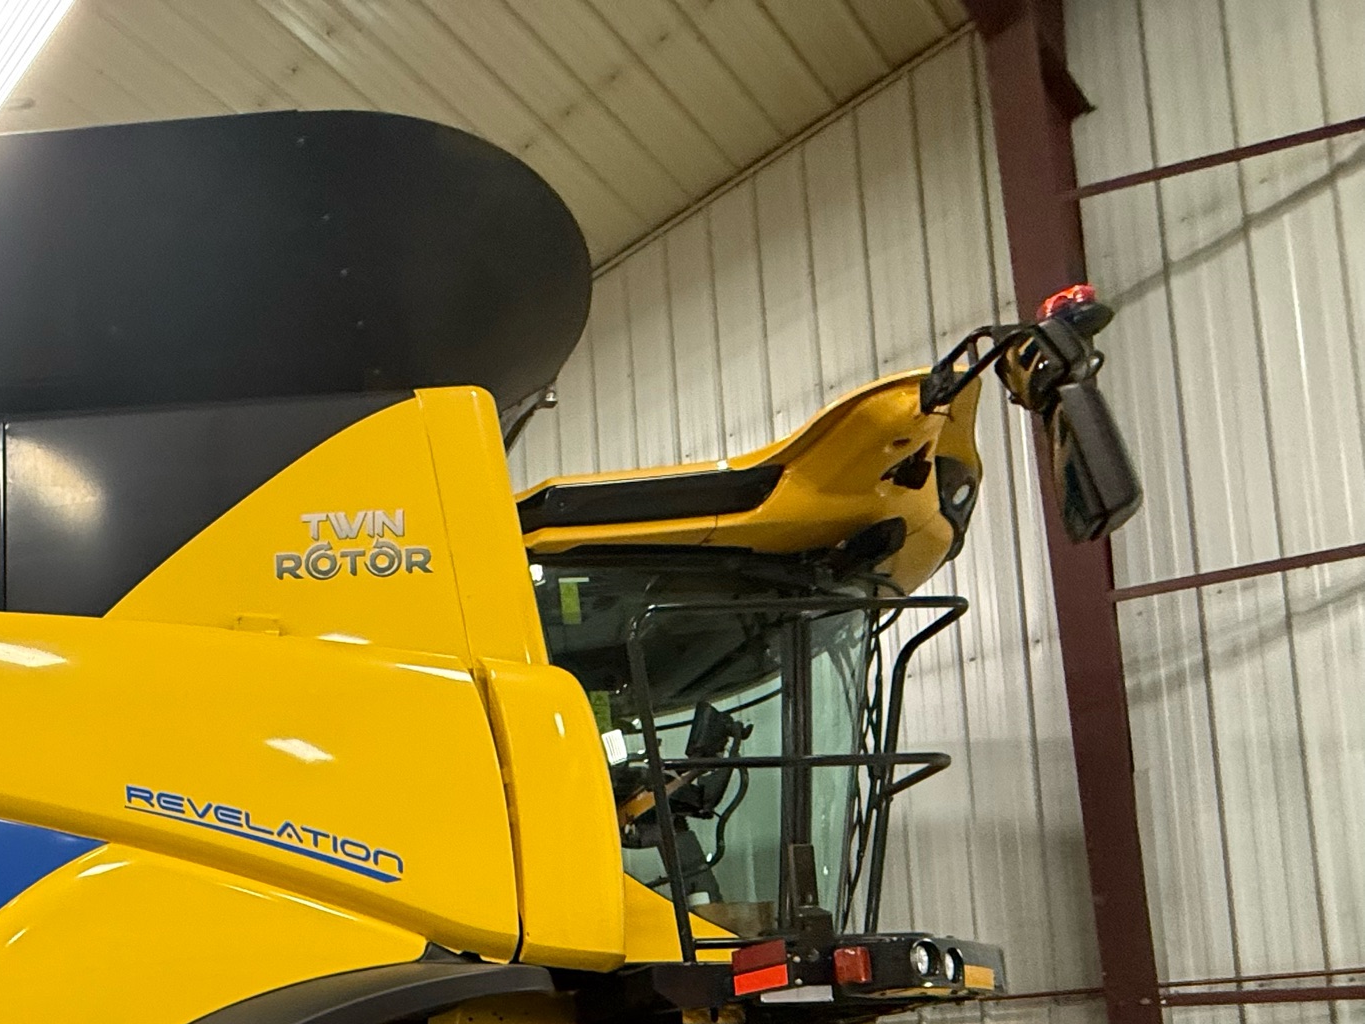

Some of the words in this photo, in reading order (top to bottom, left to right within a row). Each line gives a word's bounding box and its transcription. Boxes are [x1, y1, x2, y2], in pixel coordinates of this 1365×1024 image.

[300, 508, 405, 541] TWIN
[275, 539, 434, 581] ROTOR
[124, 784, 404, 875] REVELATION
